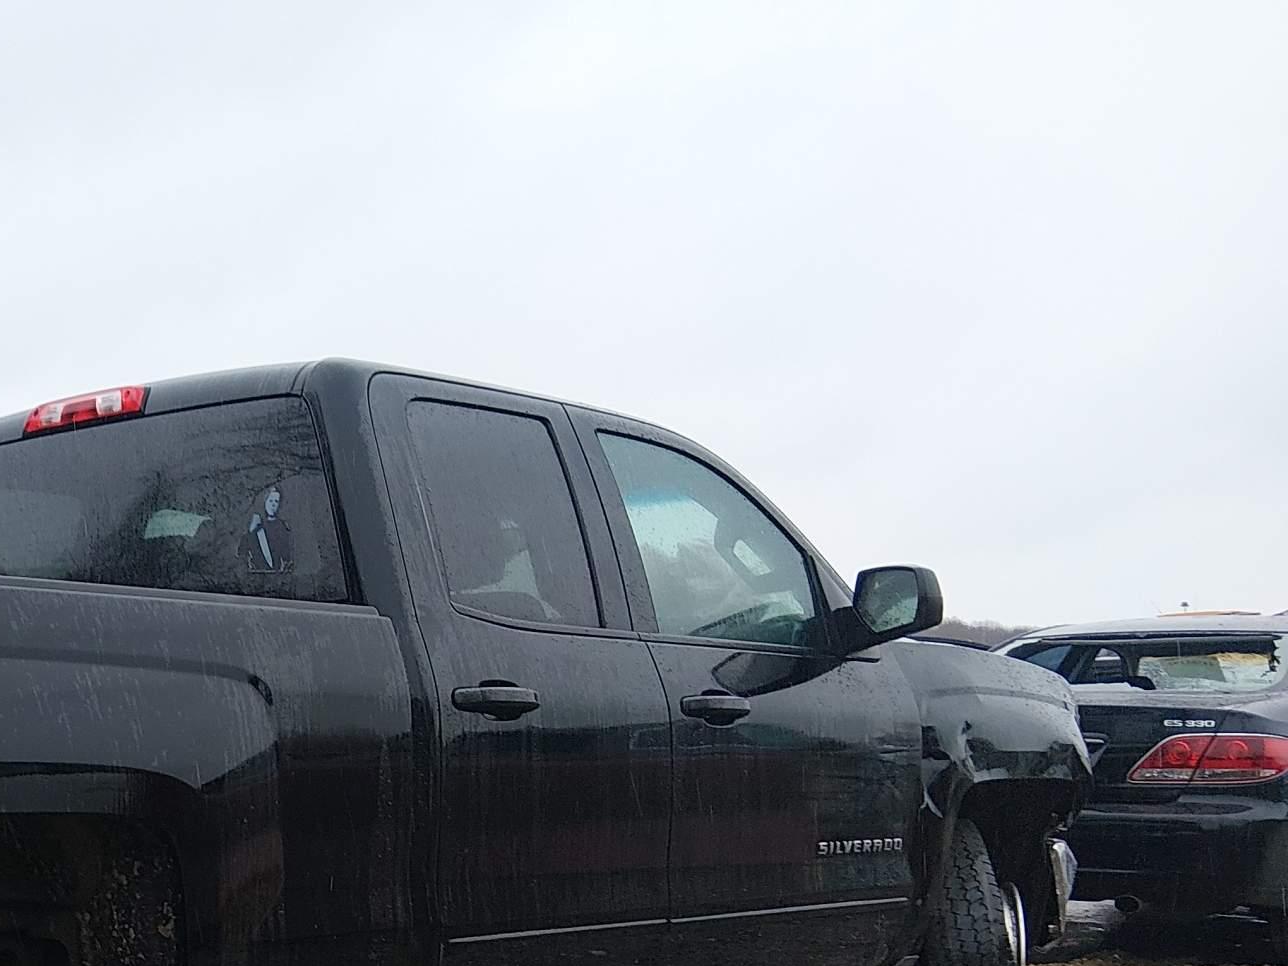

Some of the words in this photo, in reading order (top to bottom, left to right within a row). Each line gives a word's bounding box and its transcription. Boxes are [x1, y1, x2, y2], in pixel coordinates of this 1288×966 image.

[1163, 719, 1183, 728] ES
[1185, 719, 1216, 728] 330
[817, 837, 903, 855] SILVERADO
